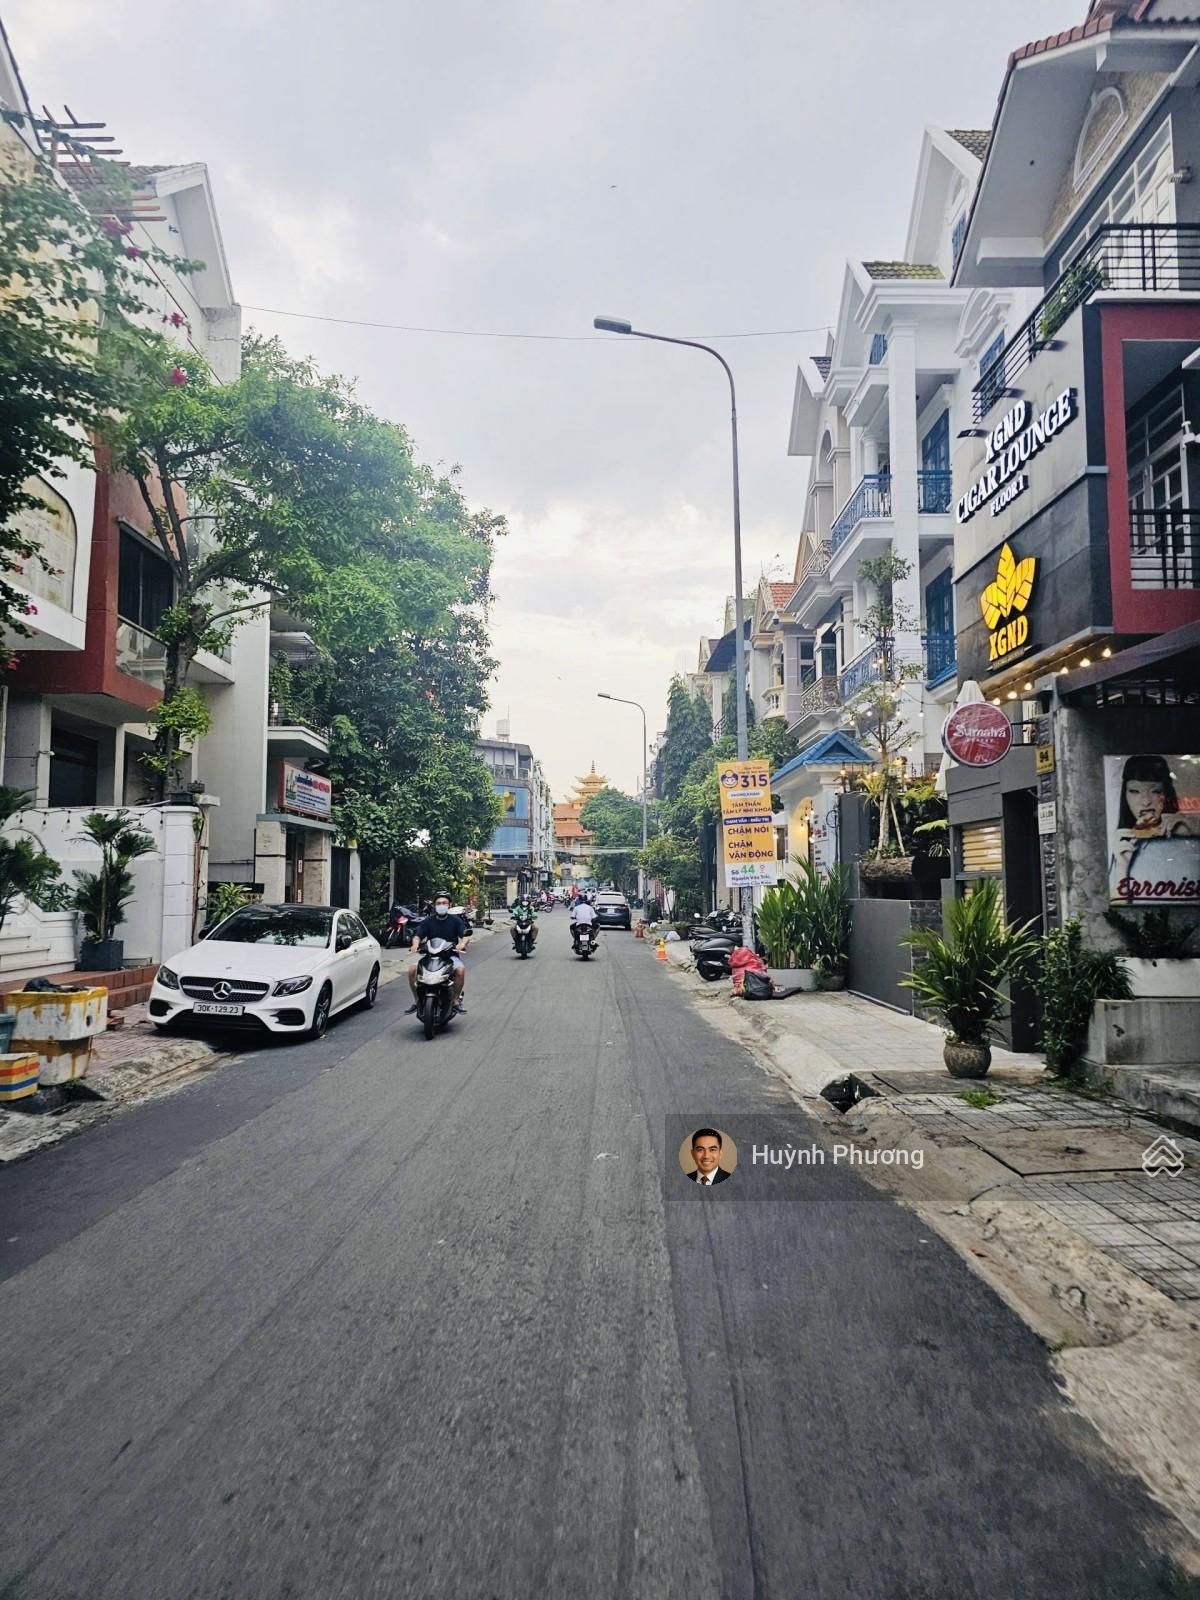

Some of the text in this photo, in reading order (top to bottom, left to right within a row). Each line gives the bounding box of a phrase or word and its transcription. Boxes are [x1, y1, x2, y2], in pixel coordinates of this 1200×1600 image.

[984, 399, 1026, 463] XGND
[955, 388, 1073, 524] CIGAR LOUNGE
[990, 480, 1018, 517] FLOOR
[988, 615, 1029, 661] XGND
[741, 774, 768, 788] 315
[728, 824, 769, 836] CHẬM NÓI
[728, 839, 753, 849] CHẬM
[729, 849, 774, 860] VẬN ĐỘNG
[740, 864, 755, 874] 44
